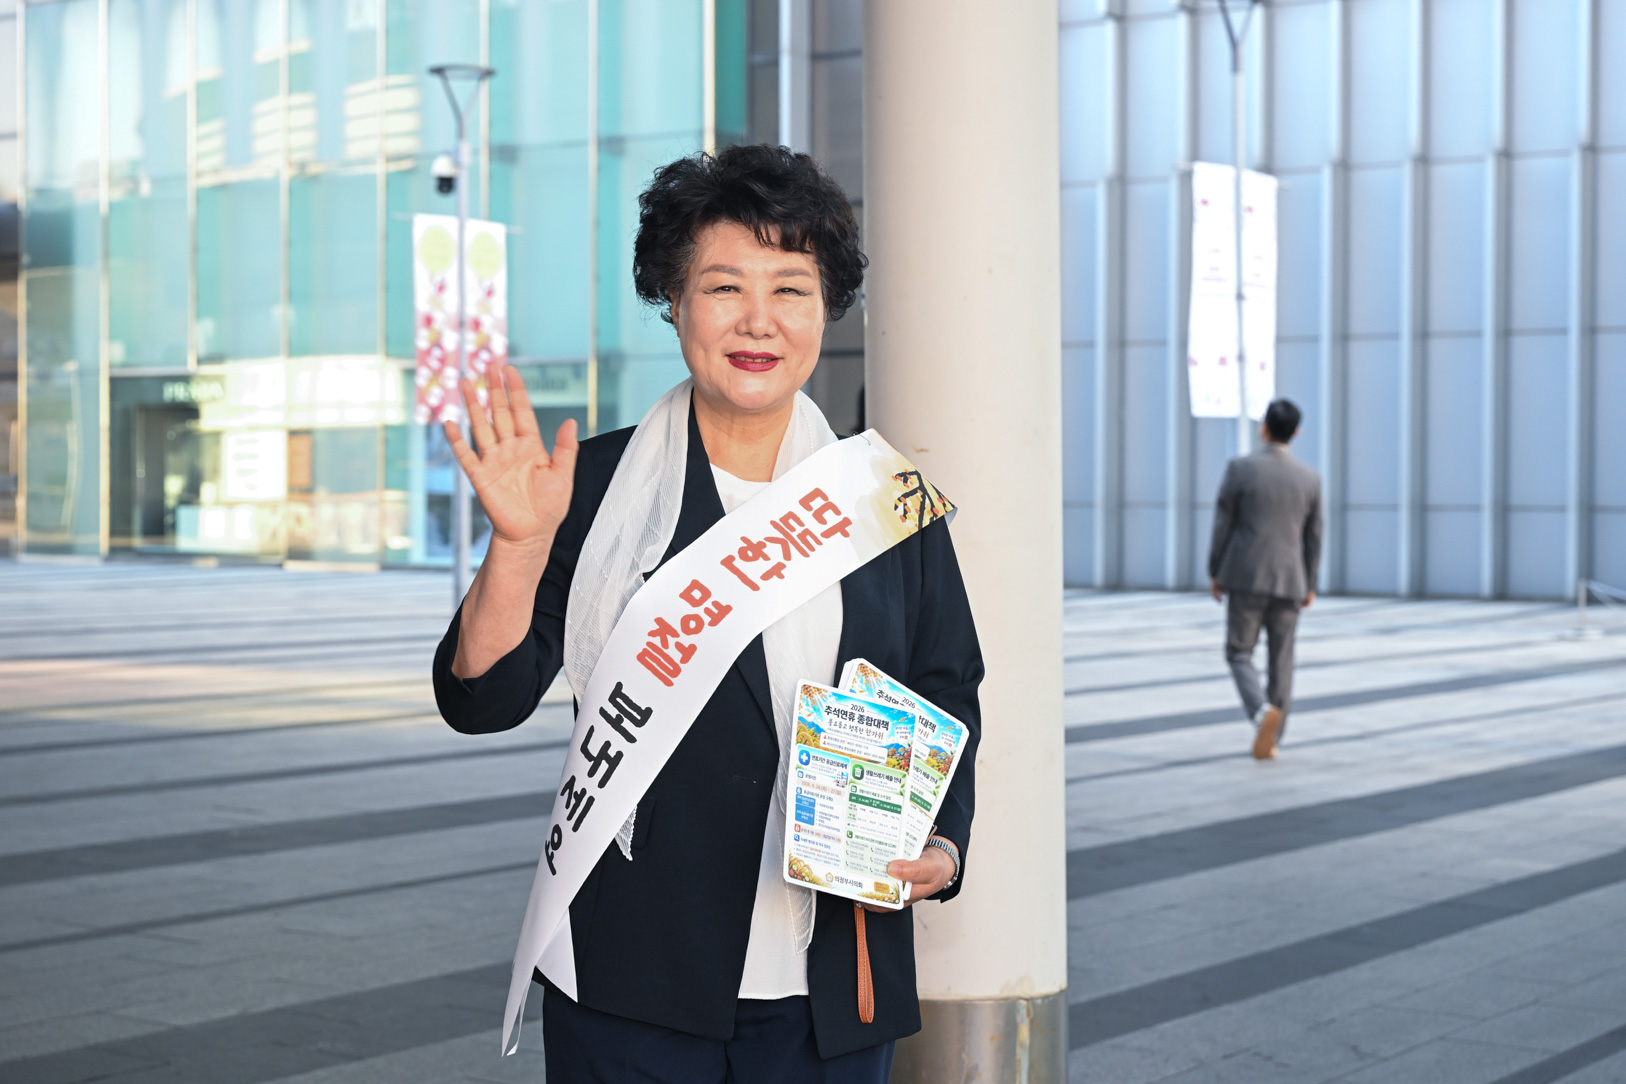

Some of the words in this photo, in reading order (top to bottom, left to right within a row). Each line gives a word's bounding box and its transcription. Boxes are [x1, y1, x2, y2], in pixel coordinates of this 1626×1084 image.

[720, 487, 853, 592] 따뜻한
[636, 579, 733, 687] 명절
[850, 703, 865, 713] 2026
[902, 697, 916, 709] 2026
[824, 705, 856, 722] 추석연휴
[857, 713, 890, 731] 종합대책
[849, 724, 864, 735] 행복한
[865, 728, 884, 740] 한가위
[917, 727, 930, 739] 가위
[544, 681, 654, 876] 보내세요
[865, 769, 885, 780] 생활쓰레기
[834, 875, 864, 889] 의정부시의회
